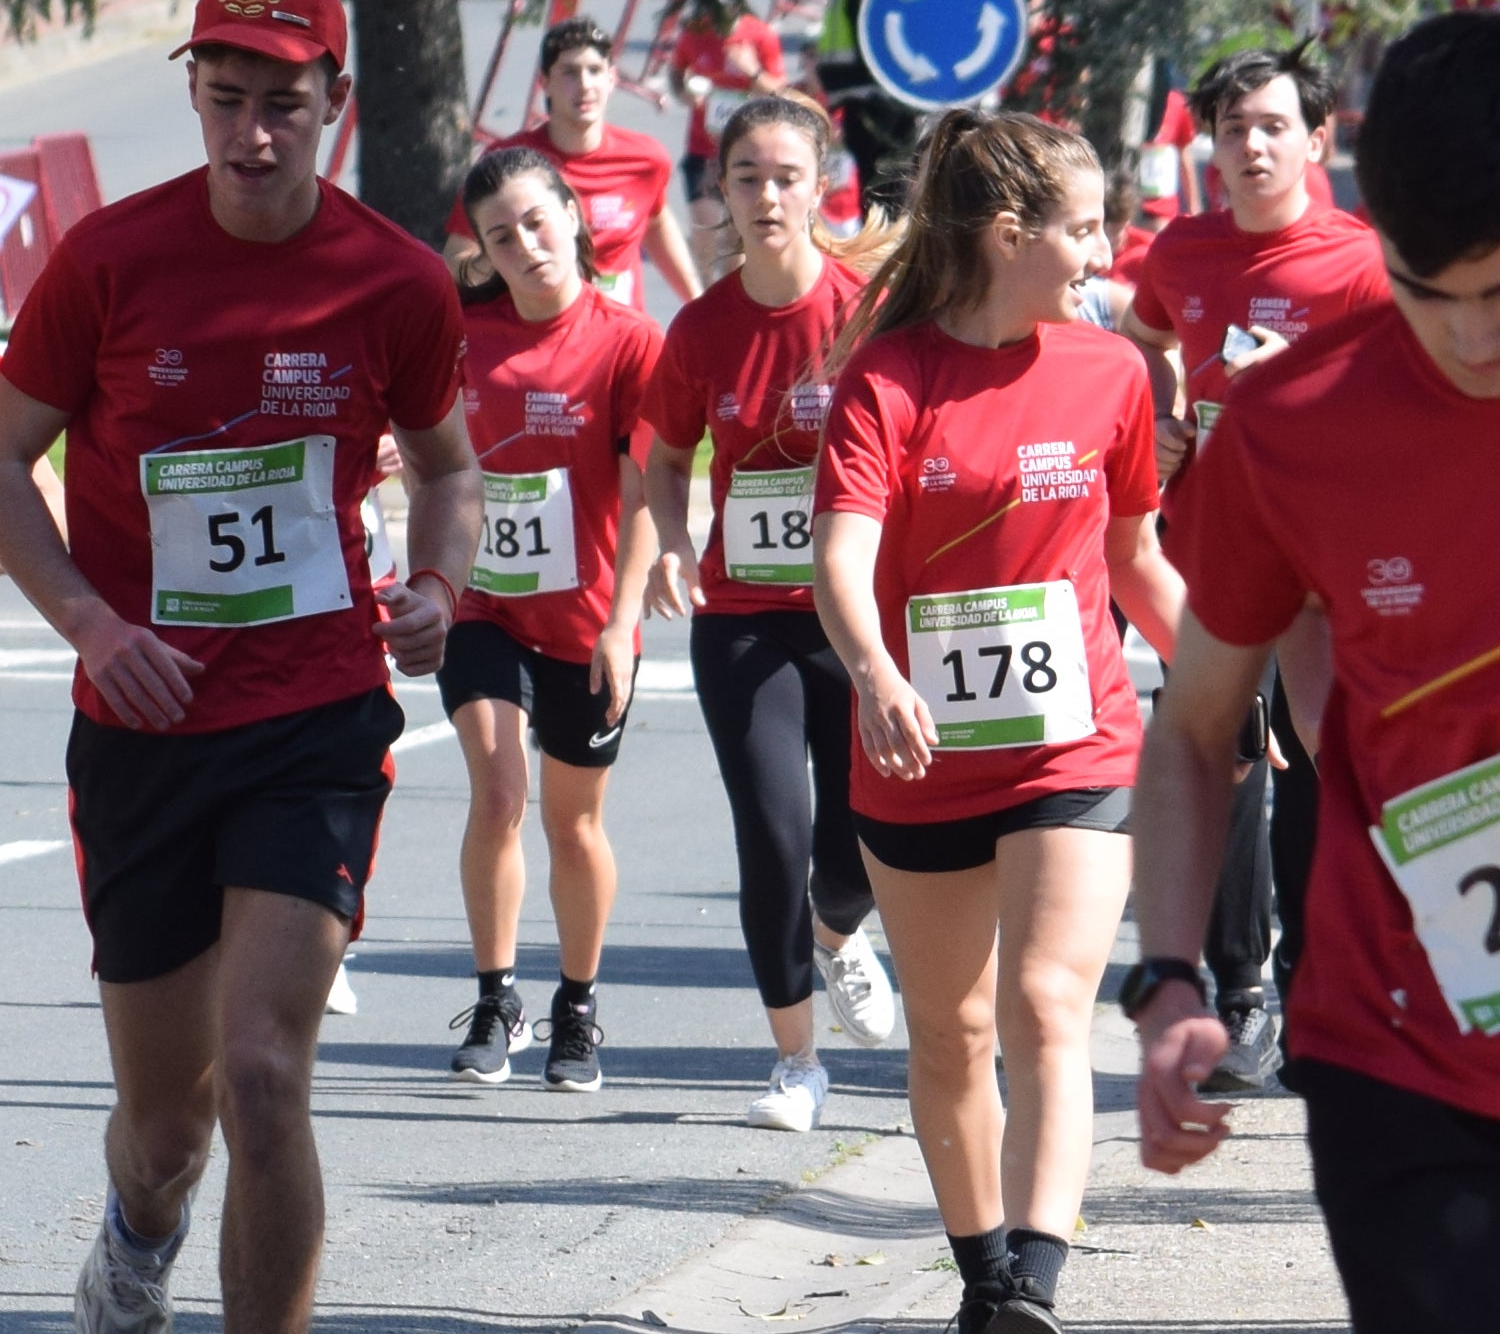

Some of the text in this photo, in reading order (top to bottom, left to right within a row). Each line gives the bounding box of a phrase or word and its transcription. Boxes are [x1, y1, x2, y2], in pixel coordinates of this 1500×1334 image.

[264, 353, 327, 367] CARRERA
[263, 370, 321, 384] CAMPUS
[262, 385, 349, 400] UNIVERSIDAD
[260, 400, 337, 417] DE LA RIOJA
[1017, 441, 1076, 458] CARRERA
[159, 458, 263, 477] CARRERA CAMPUS
[1019, 456, 1072, 472] CAMPUS
[158, 466, 296, 490] UNIVERSIDAD DE LA RIOJA
[732, 476, 804, 488] CARRERA CAMPUS
[785, 485, 796, 495] DE
[1022, 485, 1088, 502] DE LA RIOJA
[208, 505, 285, 572] 51
[750, 511, 810, 549] 18
[920, 598, 1007, 616] CARRERA CAMPUS
[920, 612, 981, 628] UNIVERSIDAD
[983, 611, 996, 623] DE
[999, 610, 1012, 621] LA
[942, 641, 1057, 702] 178
[1398, 789, 1468, 832] CARRERA
